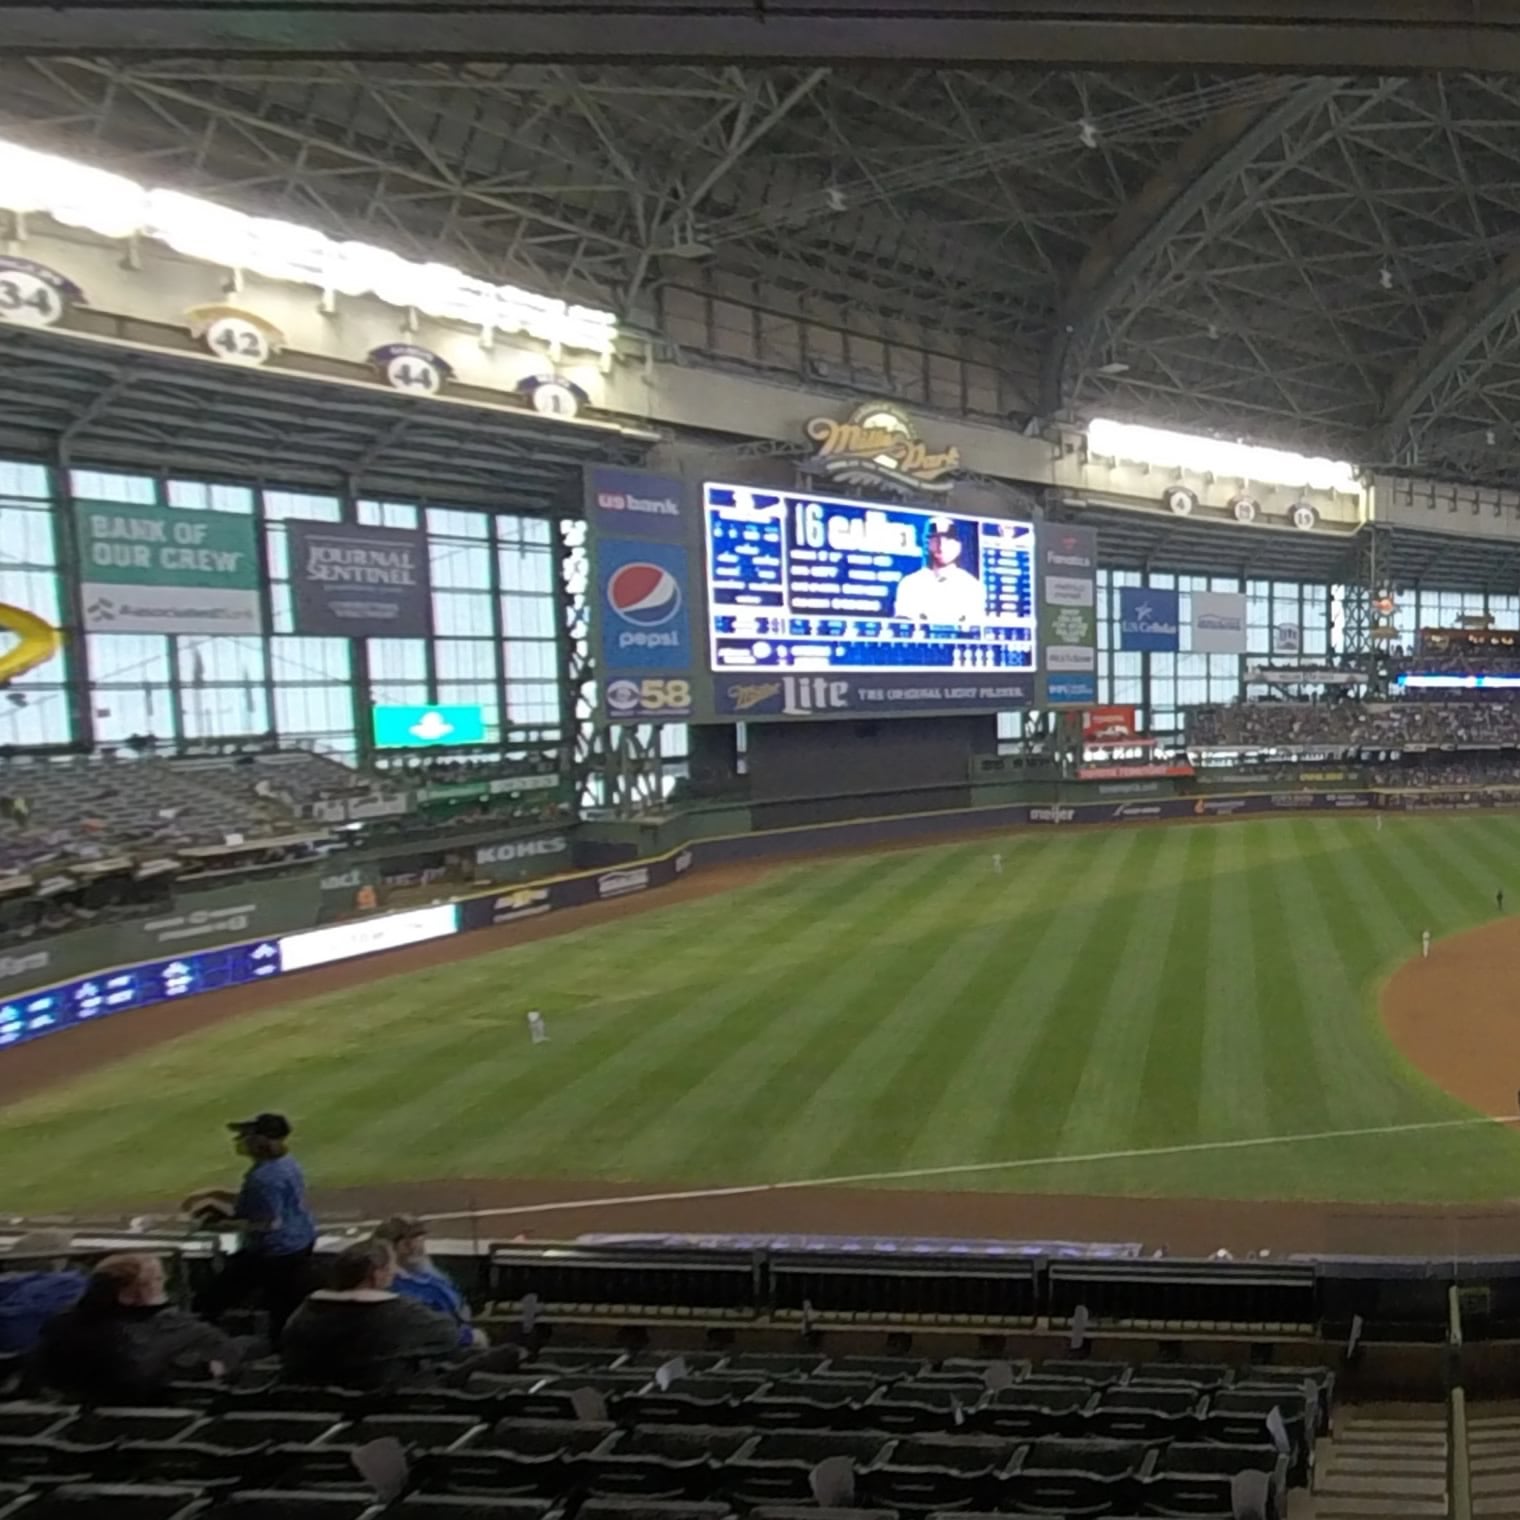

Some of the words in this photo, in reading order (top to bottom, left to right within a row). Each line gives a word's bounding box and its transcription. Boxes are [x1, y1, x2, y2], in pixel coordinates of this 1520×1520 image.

[0, 279, 51, 316] 34
[215, 328, 261, 357] 42
[394, 363, 433, 390] 44
[89, 514, 167, 543] BANK
[173, 521, 209, 545] OF
[795, 503, 824, 547] 16
[92, 542, 151, 568] OUR
[160, 546, 244, 573] CREW
[308, 546, 416, 569] JOURNAL
[306, 564, 417, 586] SENTINEL
[619, 631, 679, 648] pepsi
[641, 679, 691, 710] 58
[782, 676, 848, 715] Lite
[858, 688, 884, 701] THE
